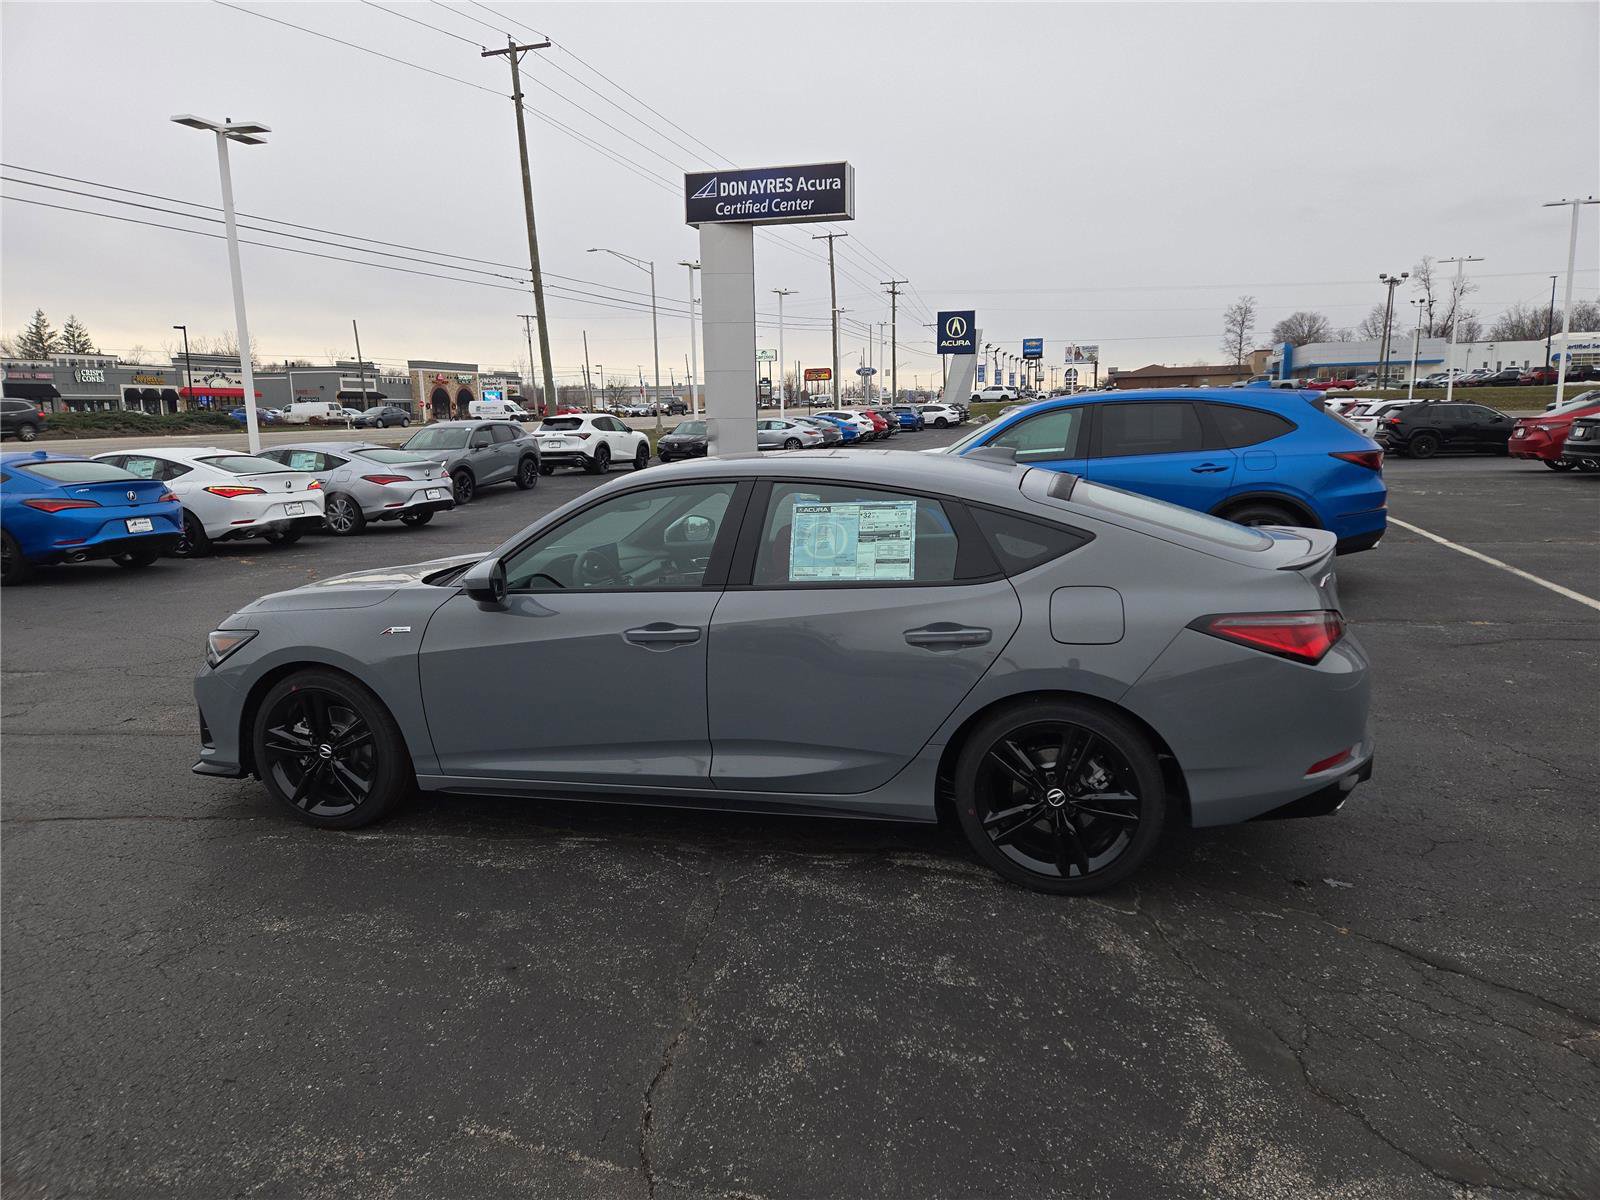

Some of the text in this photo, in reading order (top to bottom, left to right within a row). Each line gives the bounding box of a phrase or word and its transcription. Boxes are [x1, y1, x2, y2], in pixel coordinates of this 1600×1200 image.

[749, 177, 793, 195] AYRES
[796, 176, 841, 192] Acura
[715, 198, 814, 216] Certified Center
[940, 339, 971, 347] ACURA
